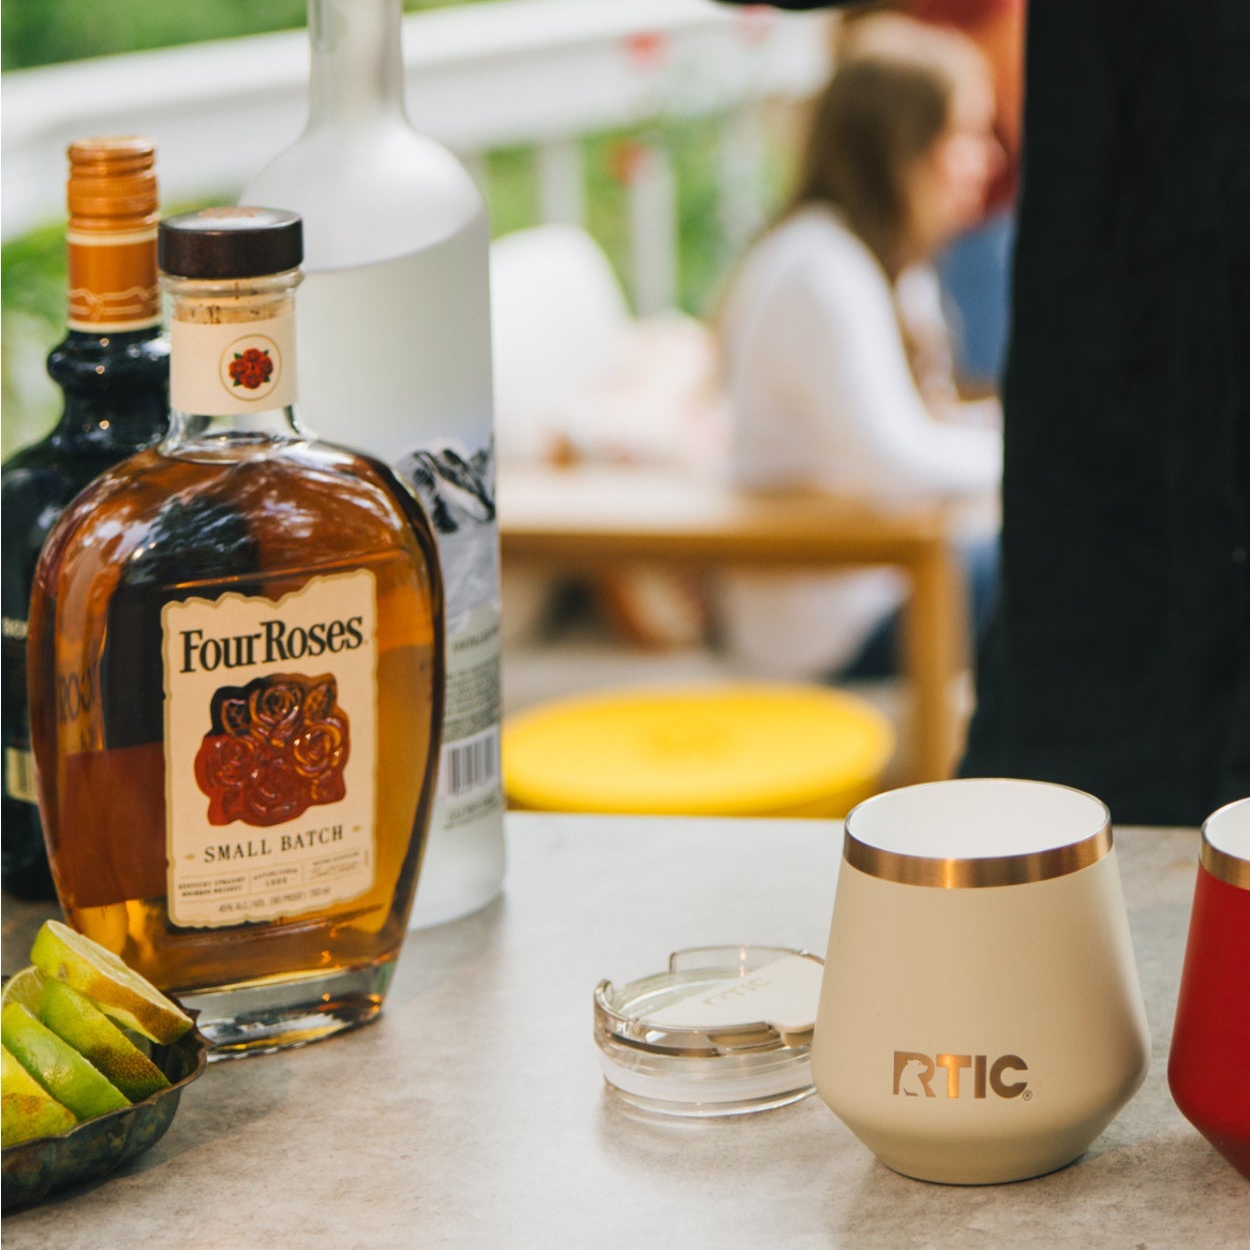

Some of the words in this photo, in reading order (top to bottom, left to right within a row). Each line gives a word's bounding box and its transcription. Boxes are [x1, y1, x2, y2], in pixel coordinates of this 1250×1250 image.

[179, 629, 262, 674] Four
[260, 616, 363, 664] Roses
[204, 839, 272, 863] SMALL
[281, 825, 343, 851] BATCH
[893, 1050, 1029, 1100] RTIC
